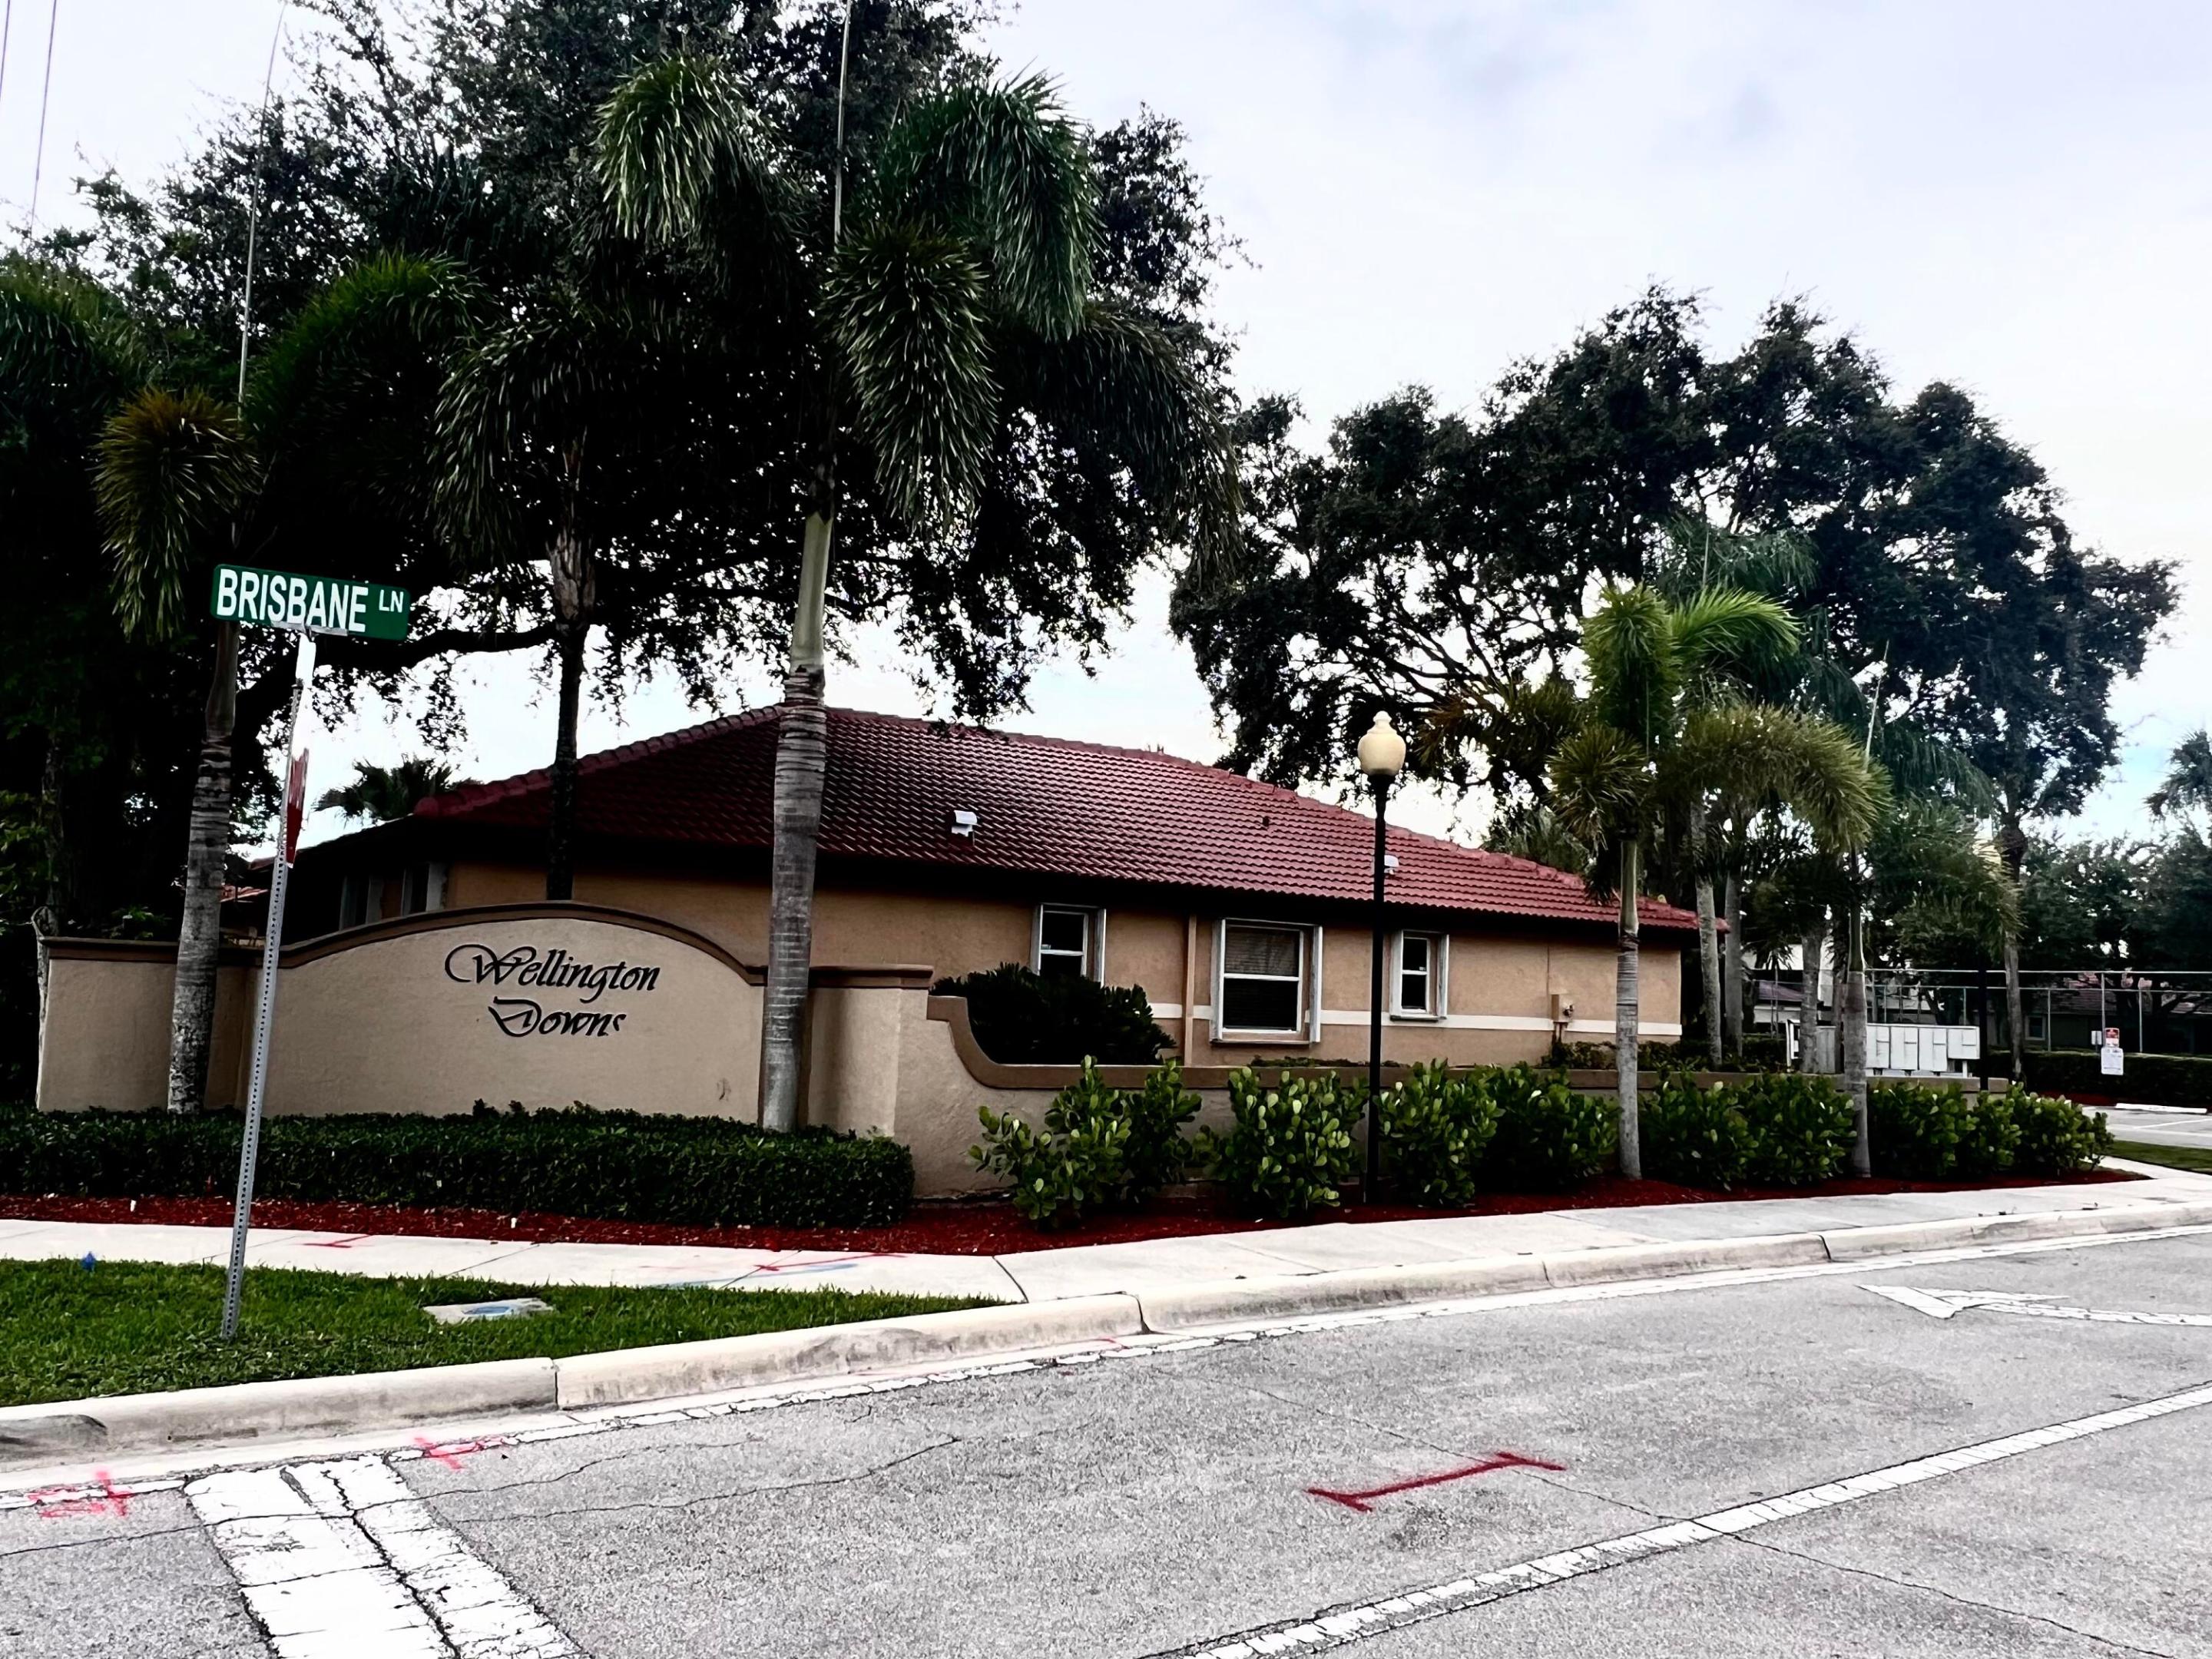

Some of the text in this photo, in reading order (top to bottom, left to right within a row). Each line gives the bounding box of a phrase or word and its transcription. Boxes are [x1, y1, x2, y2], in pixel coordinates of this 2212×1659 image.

[217, 568, 404, 632] BRISBANE LN
[445, 944, 661, 1003] Wellington
